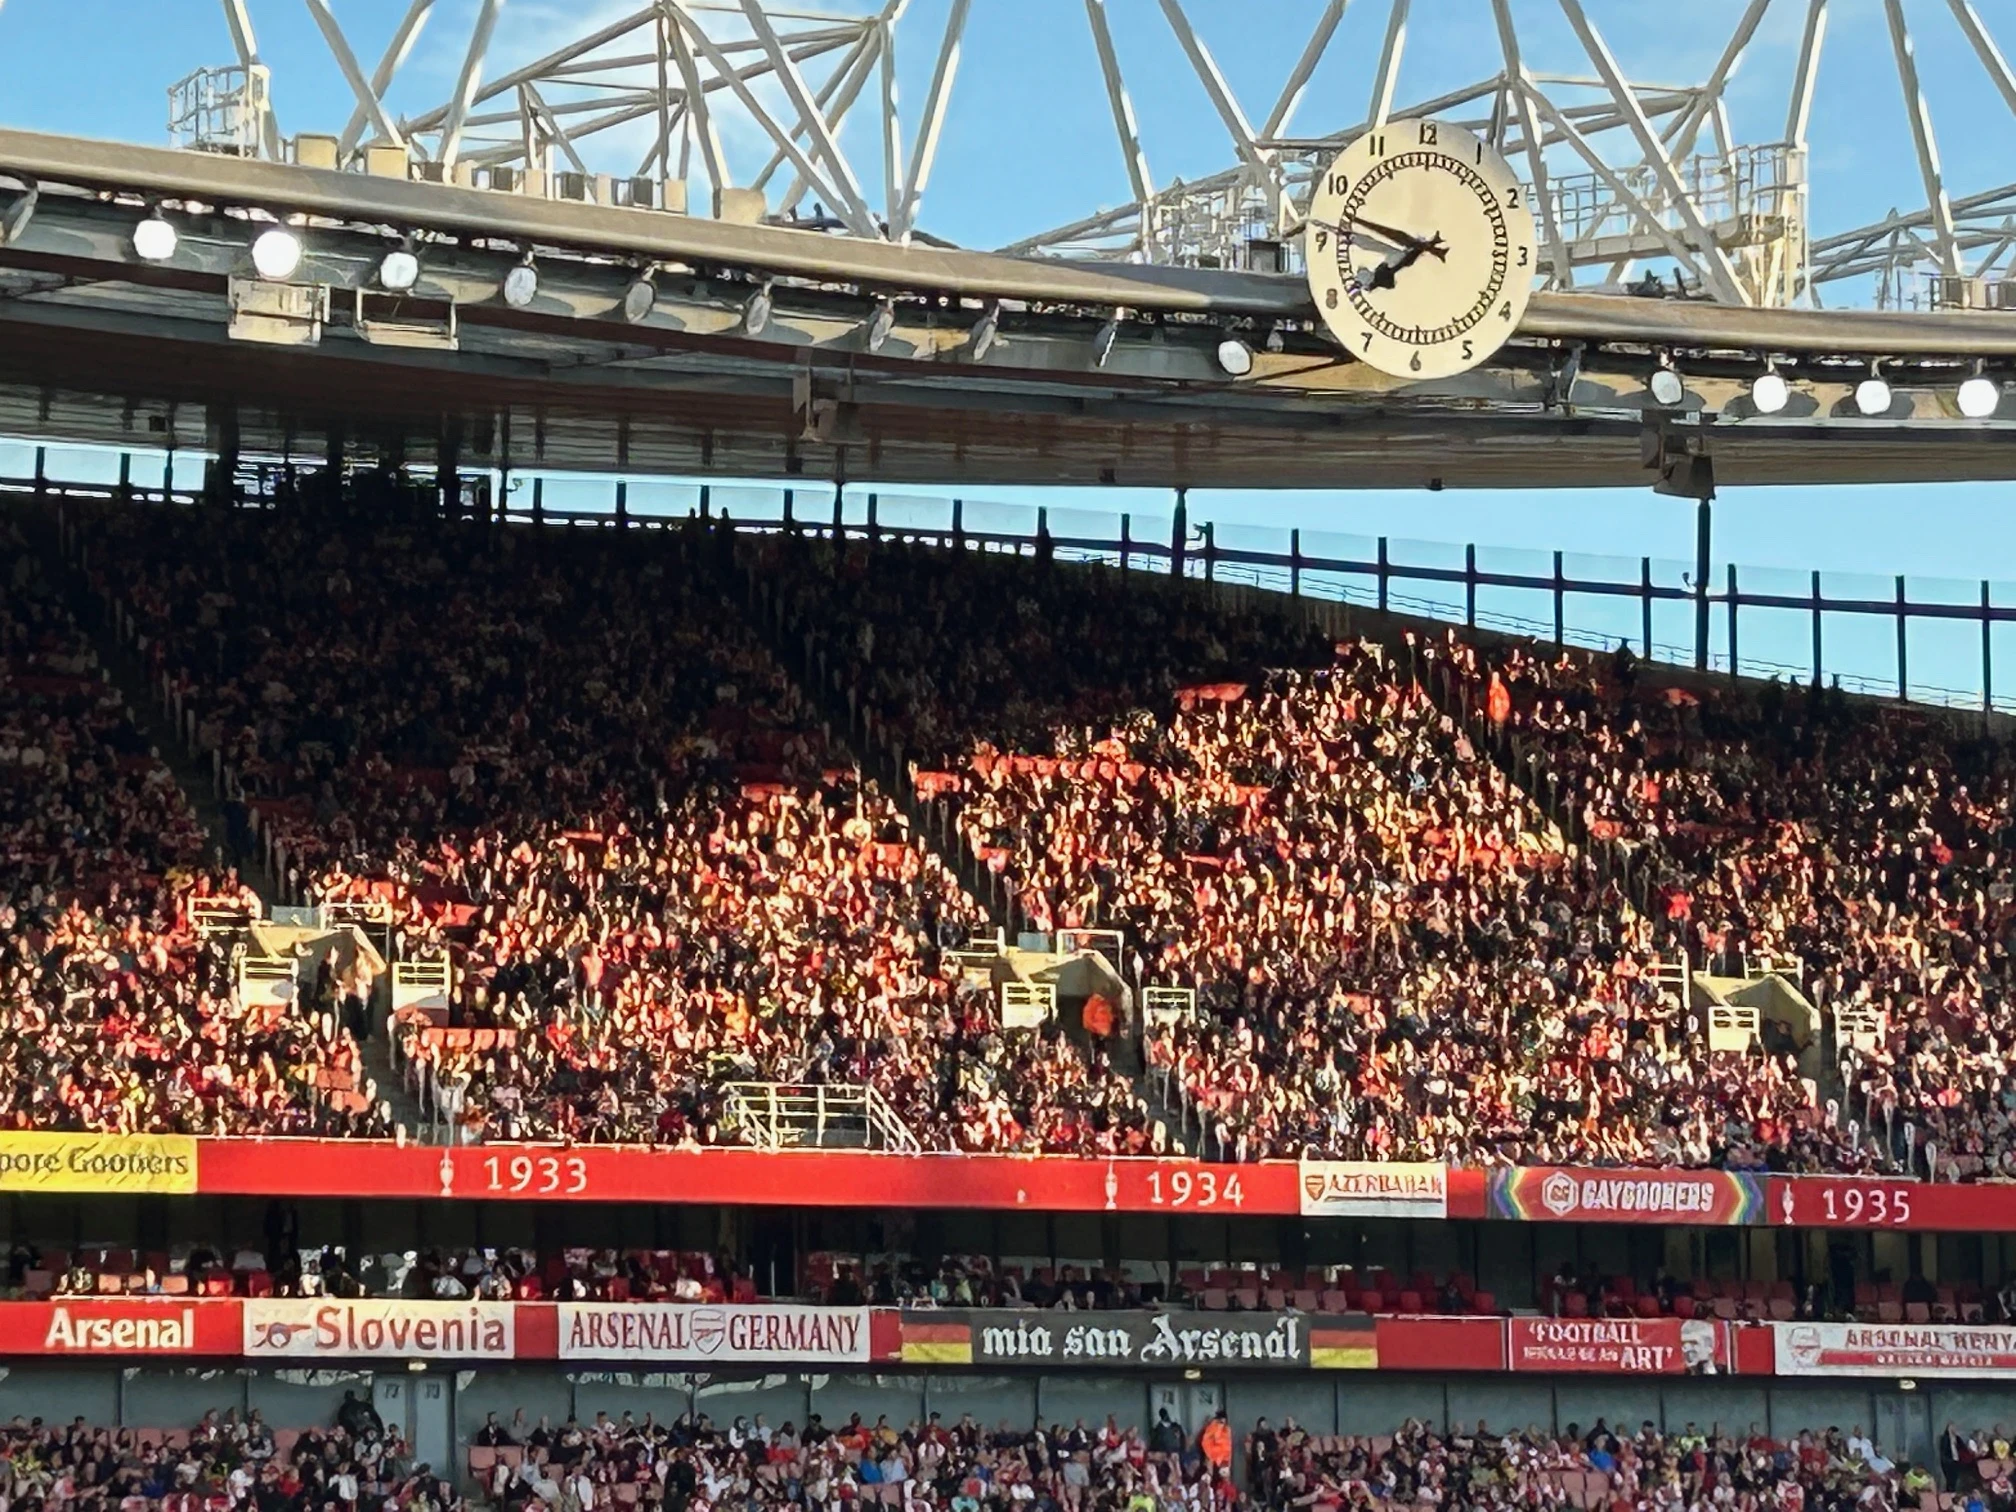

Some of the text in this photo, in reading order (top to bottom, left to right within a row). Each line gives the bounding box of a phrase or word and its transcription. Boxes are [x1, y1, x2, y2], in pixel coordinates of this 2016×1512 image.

[1419, 123, 1437, 145] 12
[1369, 135, 1384, 157] 11
[1475, 142, 1482, 164] 1
[1328, 173, 1348, 195] 10
[1506, 188, 1519, 209] 2
[1315, 231, 1328, 252] 9
[1517, 246, 1528, 267] 3
[1325, 288, 1338, 309] 8
[1498, 300, 1511, 322] 4
[1361, 331, 1373, 352] 7
[1461, 340, 1473, 360] 5
[1410, 350, 1421, 371] 6
[68, 1147, 188, 1174] Gooners
[484, 1156, 587, 1193] 1933
[1147, 1171, 1244, 1207] 1934
[1823, 1189, 1910, 1223] 1935
[44, 1307, 194, 1349] Arsenal
[315, 1305, 506, 1351] Slovenia
[569, 1311, 861, 1354] ARSENAL GERMANY
[1063, 1325, 1132, 1358] san
[1140, 1313, 1301, 1361] Arsenal
[1845, 1329, 2016, 1351] ARSENAL KENY
